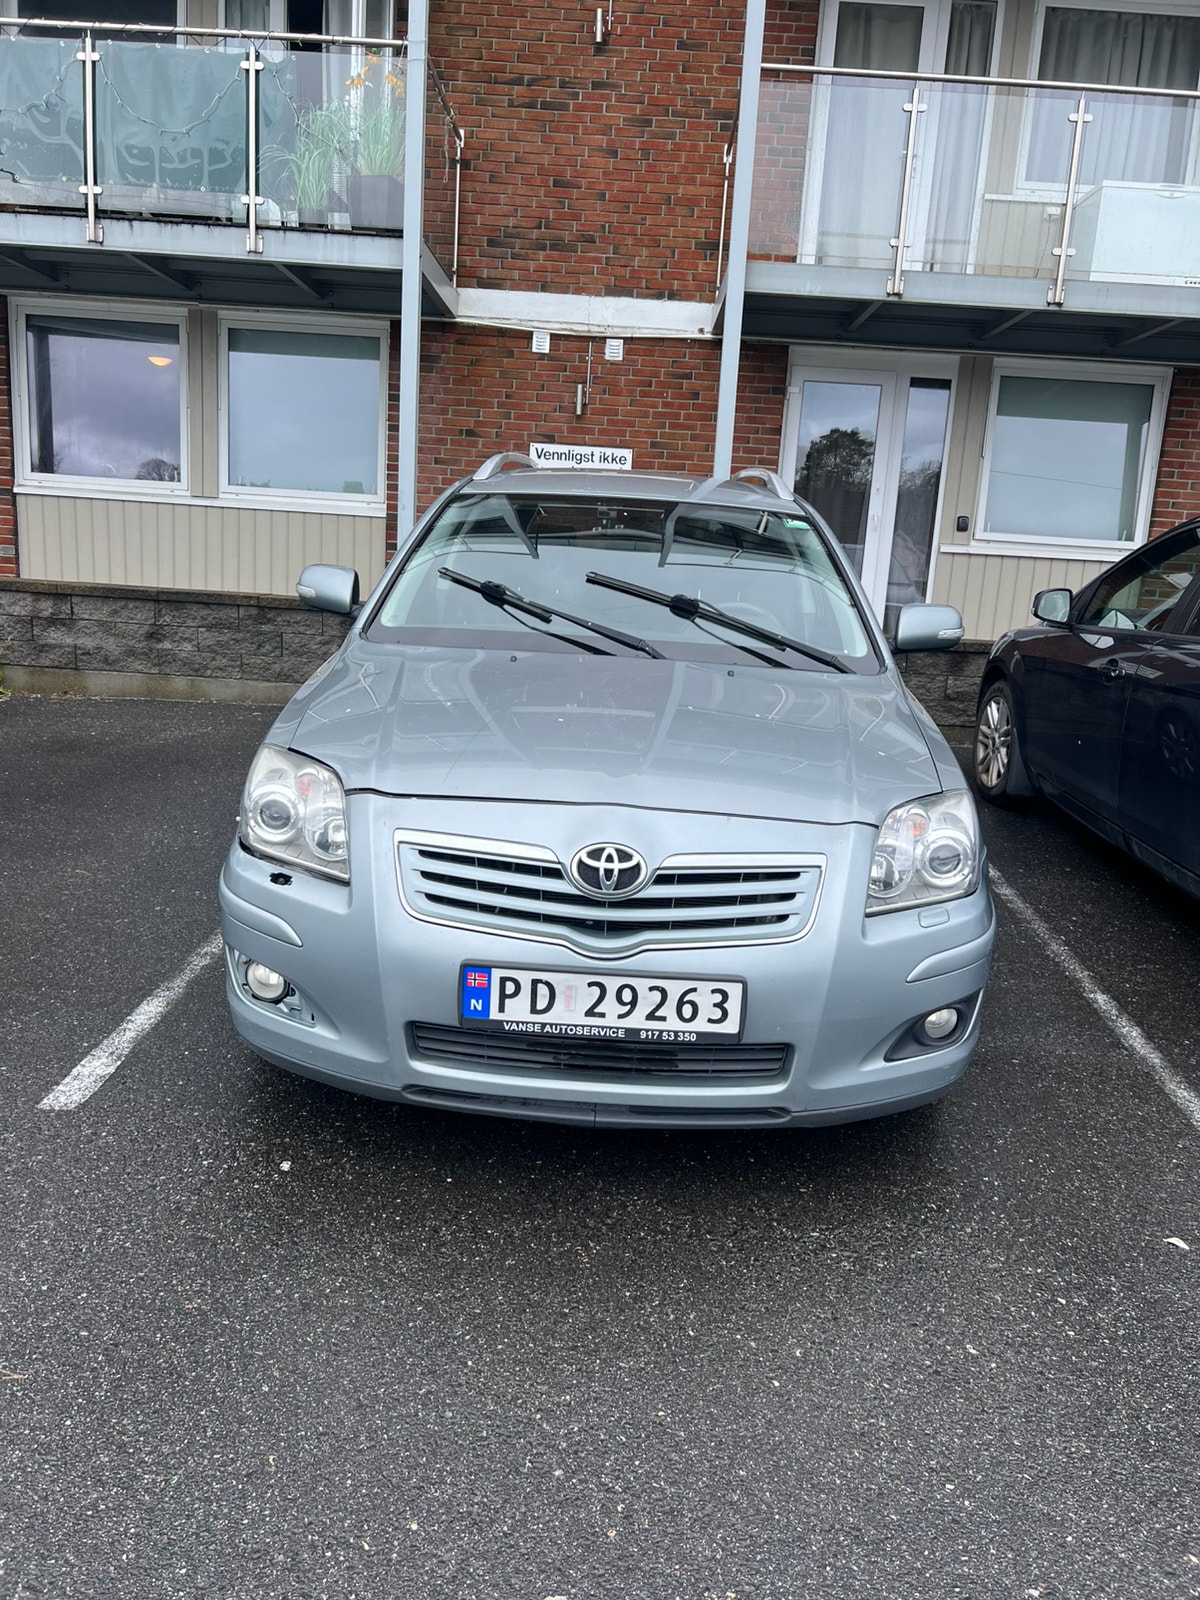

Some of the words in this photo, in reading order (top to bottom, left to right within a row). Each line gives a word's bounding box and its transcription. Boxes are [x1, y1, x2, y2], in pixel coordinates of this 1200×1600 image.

[535, 447, 595, 464] Vennligst
[599, 452, 627, 465] ikke
[470, 998, 482, 1011] N
[498, 976, 557, 1015] PD
[584, 980, 730, 1025] 29263
[503, 1021, 542, 1033] VANSE
[543, 1023, 626, 1038] AUTOSERVICE
[640, 1030, 660, 1040] 917
[662, 1031, 676, 1041] 53
[677, 1032, 697, 1042] 350
